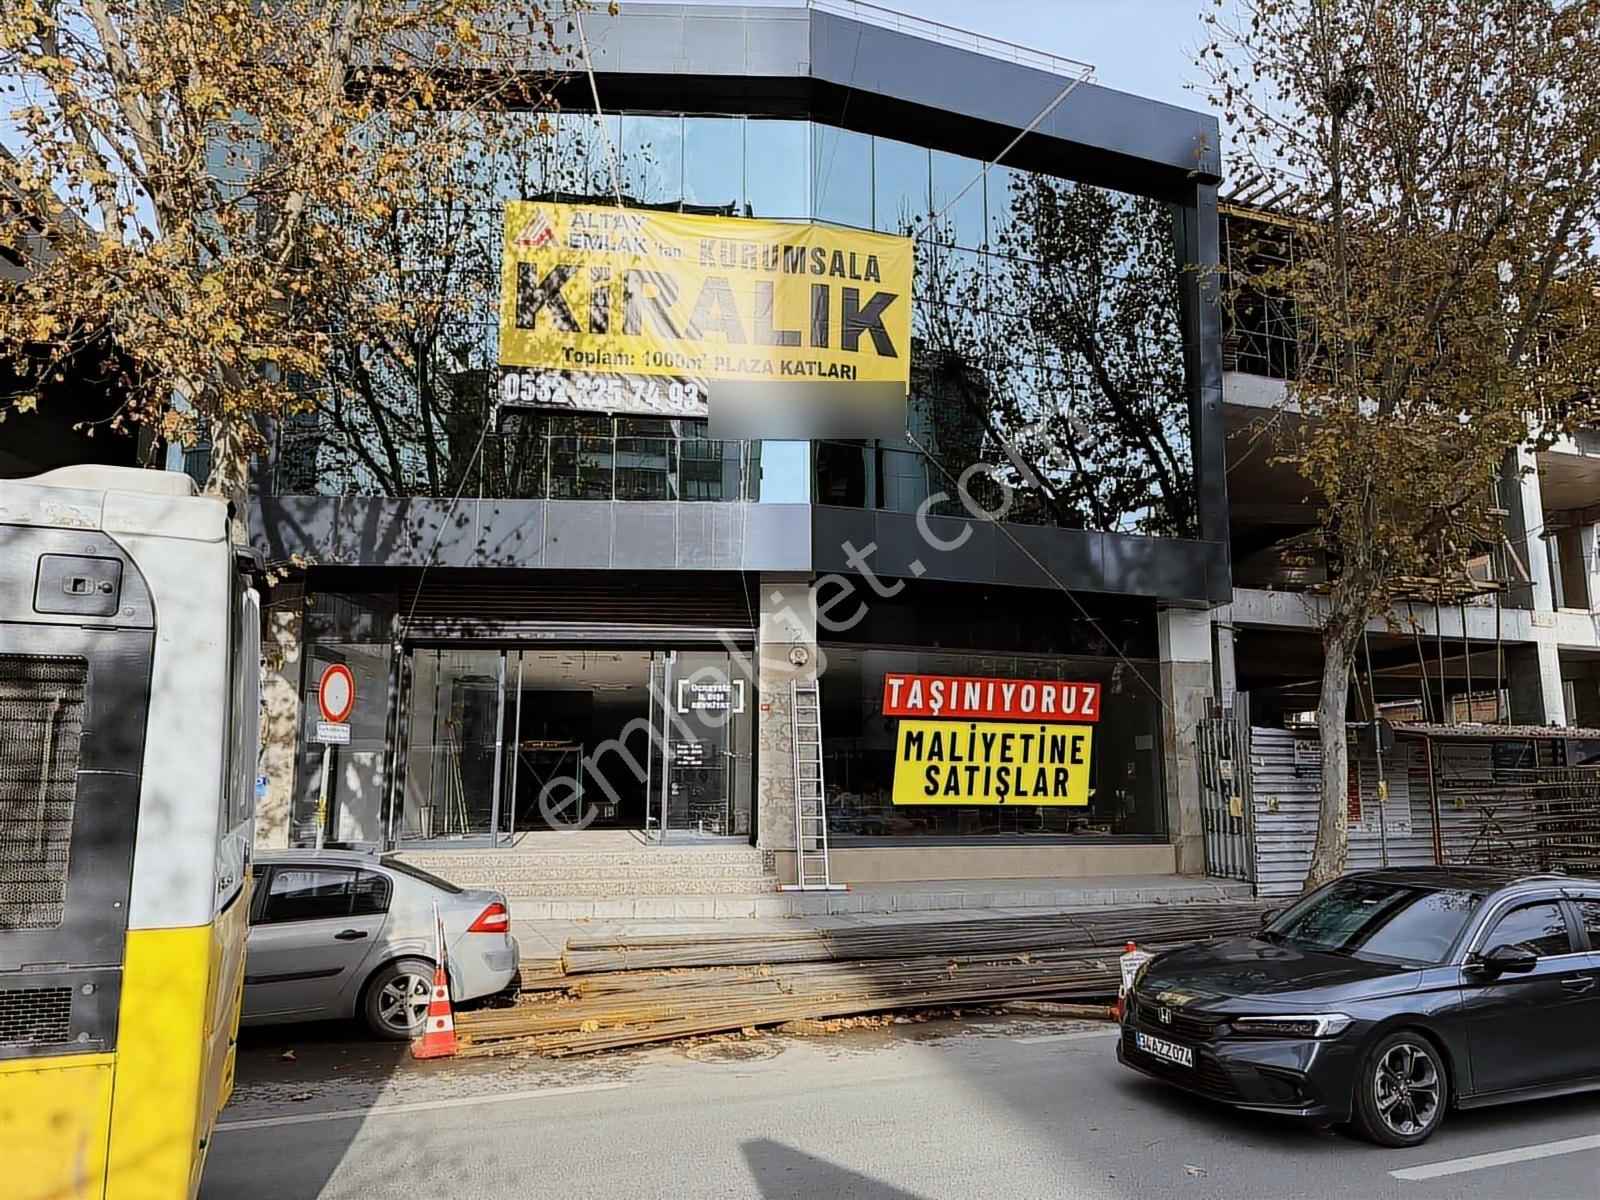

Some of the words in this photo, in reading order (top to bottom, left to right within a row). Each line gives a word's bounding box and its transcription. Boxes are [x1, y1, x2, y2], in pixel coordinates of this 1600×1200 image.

[570, 212, 648, 231] ALTAY
[569, 233, 648, 253] EMLAK
[699, 239, 881, 283] KURUMSALA
[562, 346, 636, 367] Toplam:
[714, 356, 774, 376] PLAZA
[780, 360, 857, 380] KATLARI
[503, 372, 568, 403] 0532
[630, 379, 662, 409] 74
[668, 382, 700, 410] 93
[888, 678, 1098, 716] TAŞINIYORUZ
[903, 723, 1086, 764] MALİYETİNE
[924, 764, 1069, 804] SATIŞLAR
